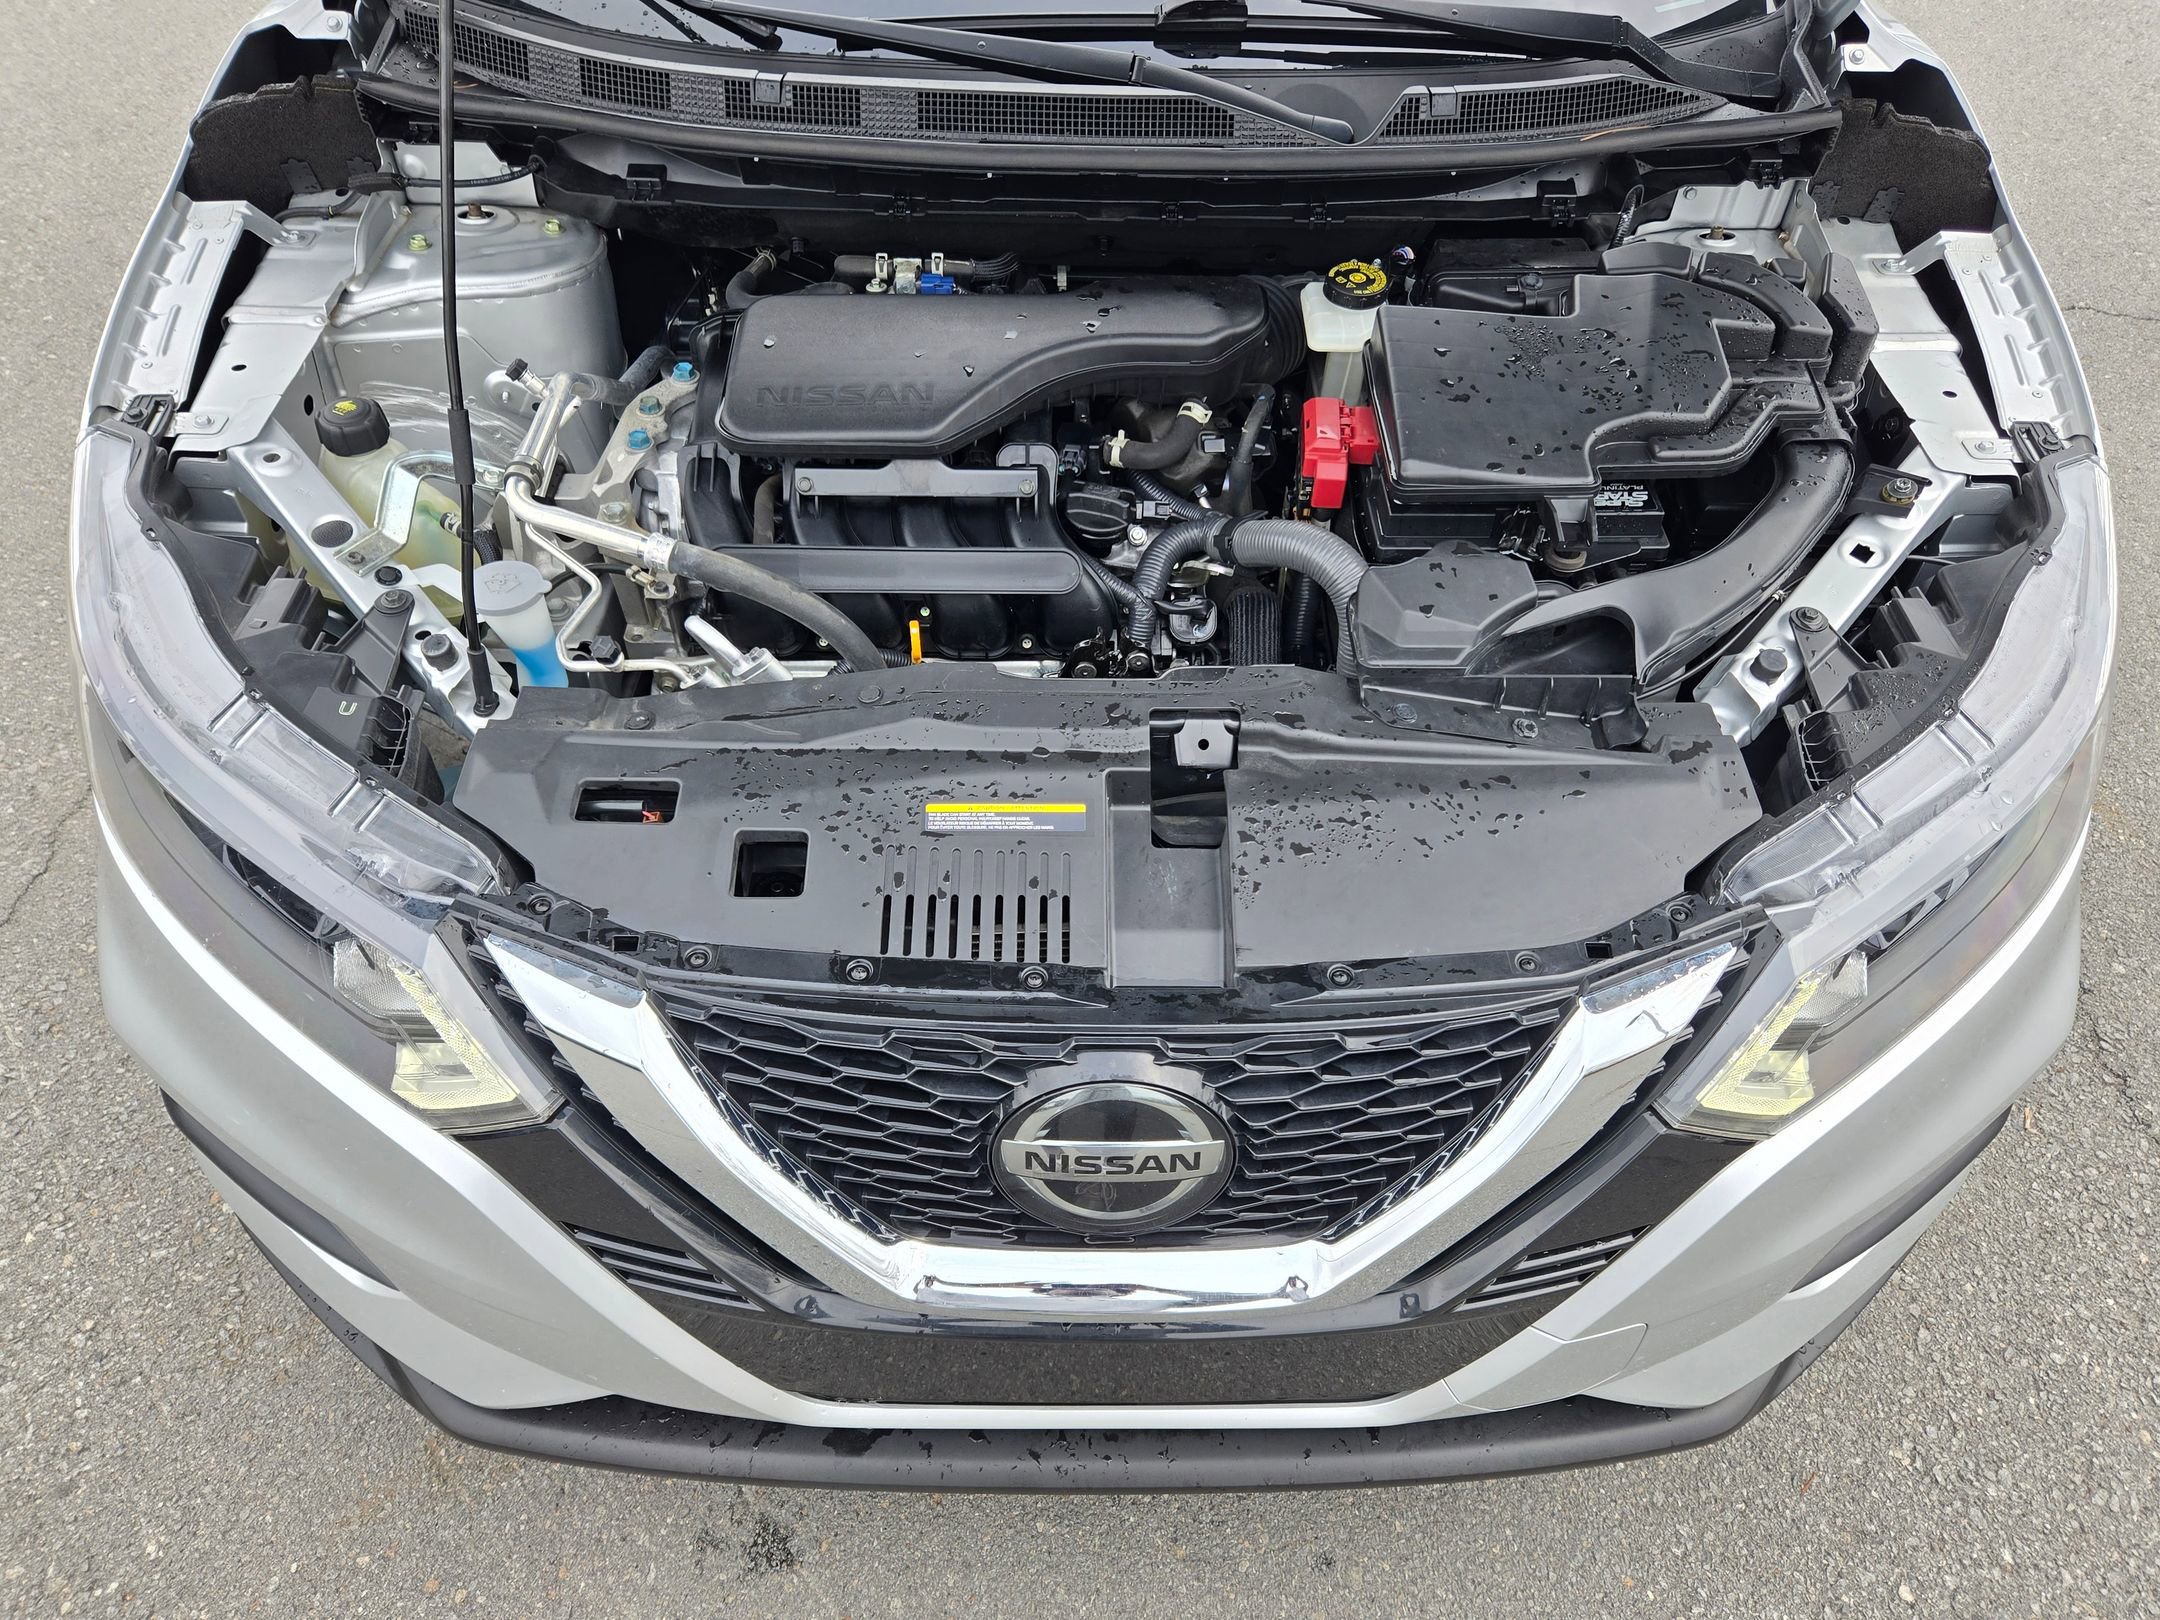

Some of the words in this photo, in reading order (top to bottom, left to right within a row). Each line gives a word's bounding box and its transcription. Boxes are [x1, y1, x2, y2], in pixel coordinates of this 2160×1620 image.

[756, 381, 935, 407] NISSAN
[1594, 499, 1643, 507] SUPE
[1596, 491, 1648, 501] STAR
[1025, 1151, 1201, 1175] NISSAN
